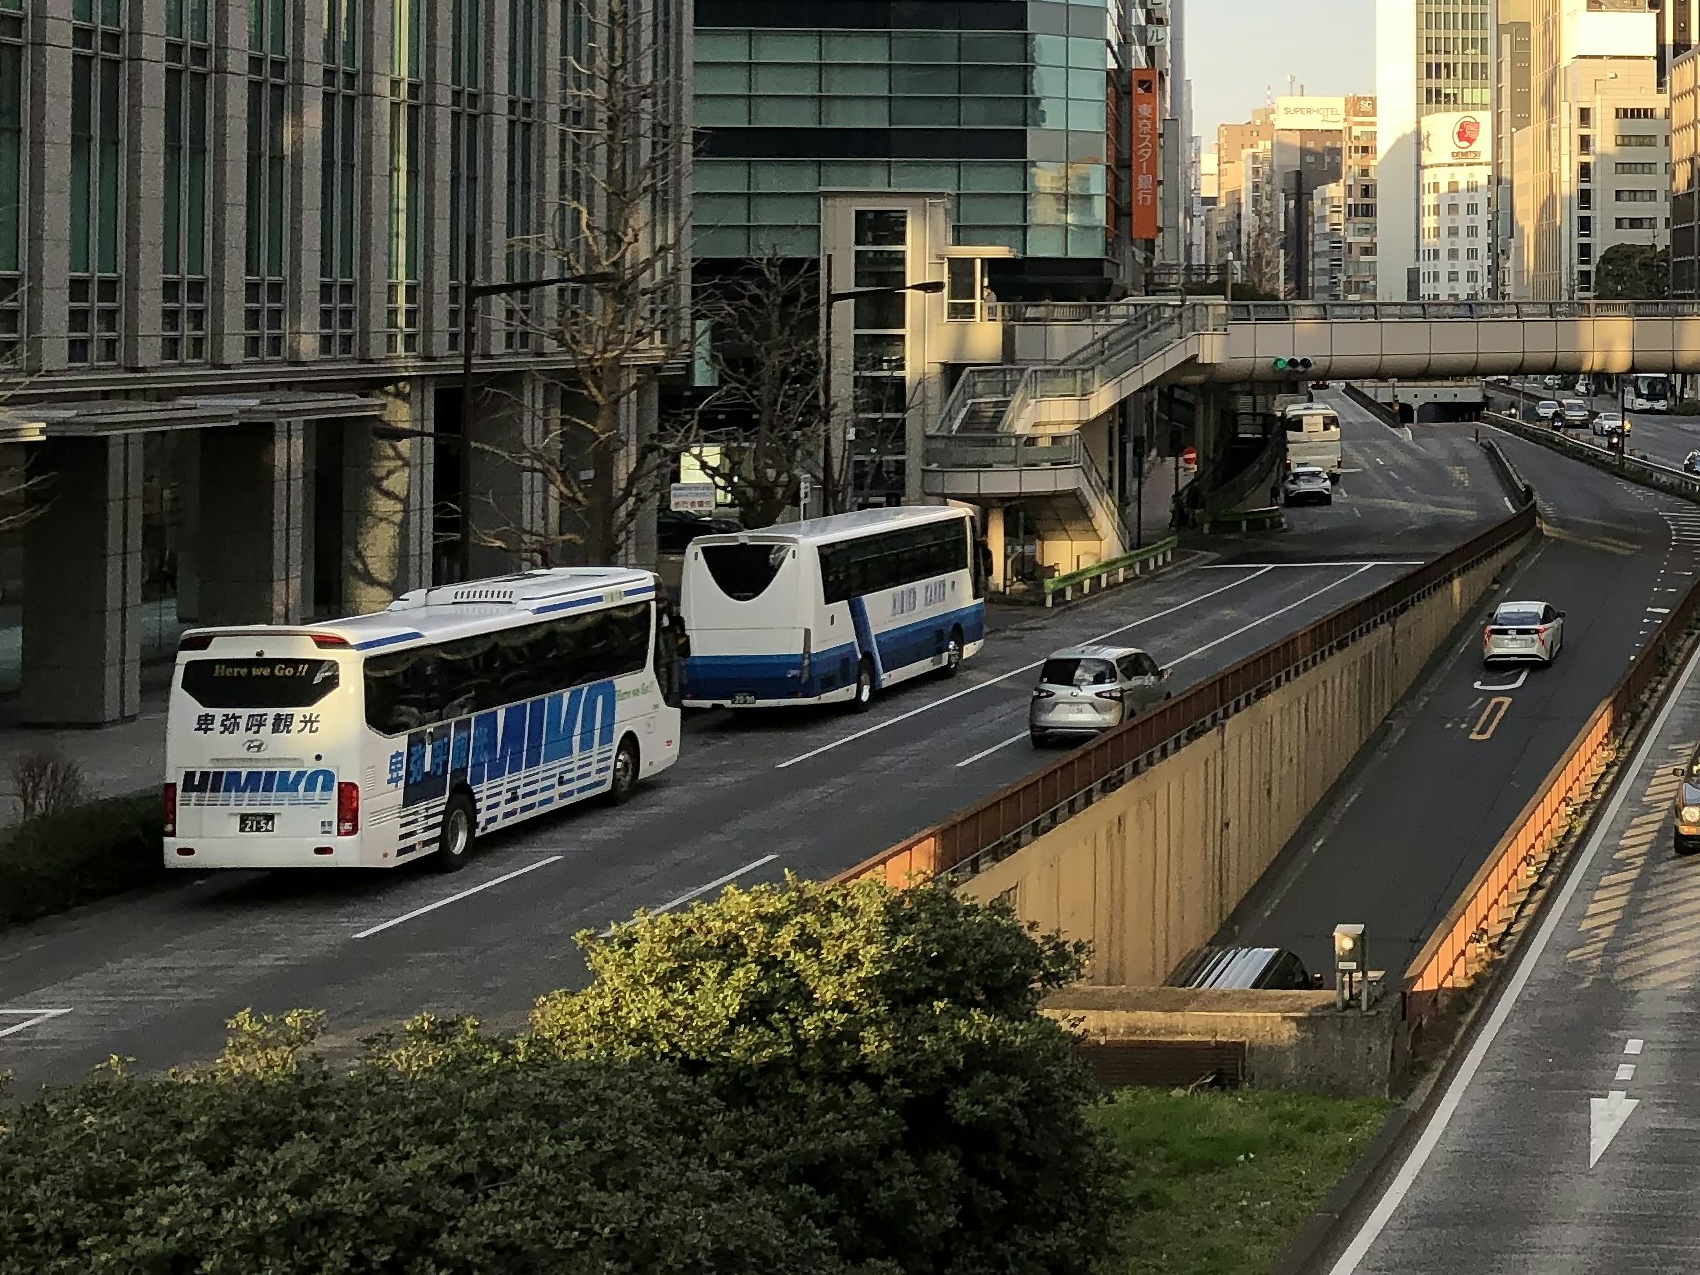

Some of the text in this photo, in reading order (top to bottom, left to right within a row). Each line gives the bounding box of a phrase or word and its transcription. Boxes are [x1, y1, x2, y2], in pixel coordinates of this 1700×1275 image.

[1138, 103, 1153, 205] 東京スター銀行
[213, 663, 247, 677] Here
[252, 666, 271, 676] we
[274, 663, 294, 676] Go
[193, 712, 321, 735] 卑弥呼観光
[179, 768, 336, 807] HIMIKO
